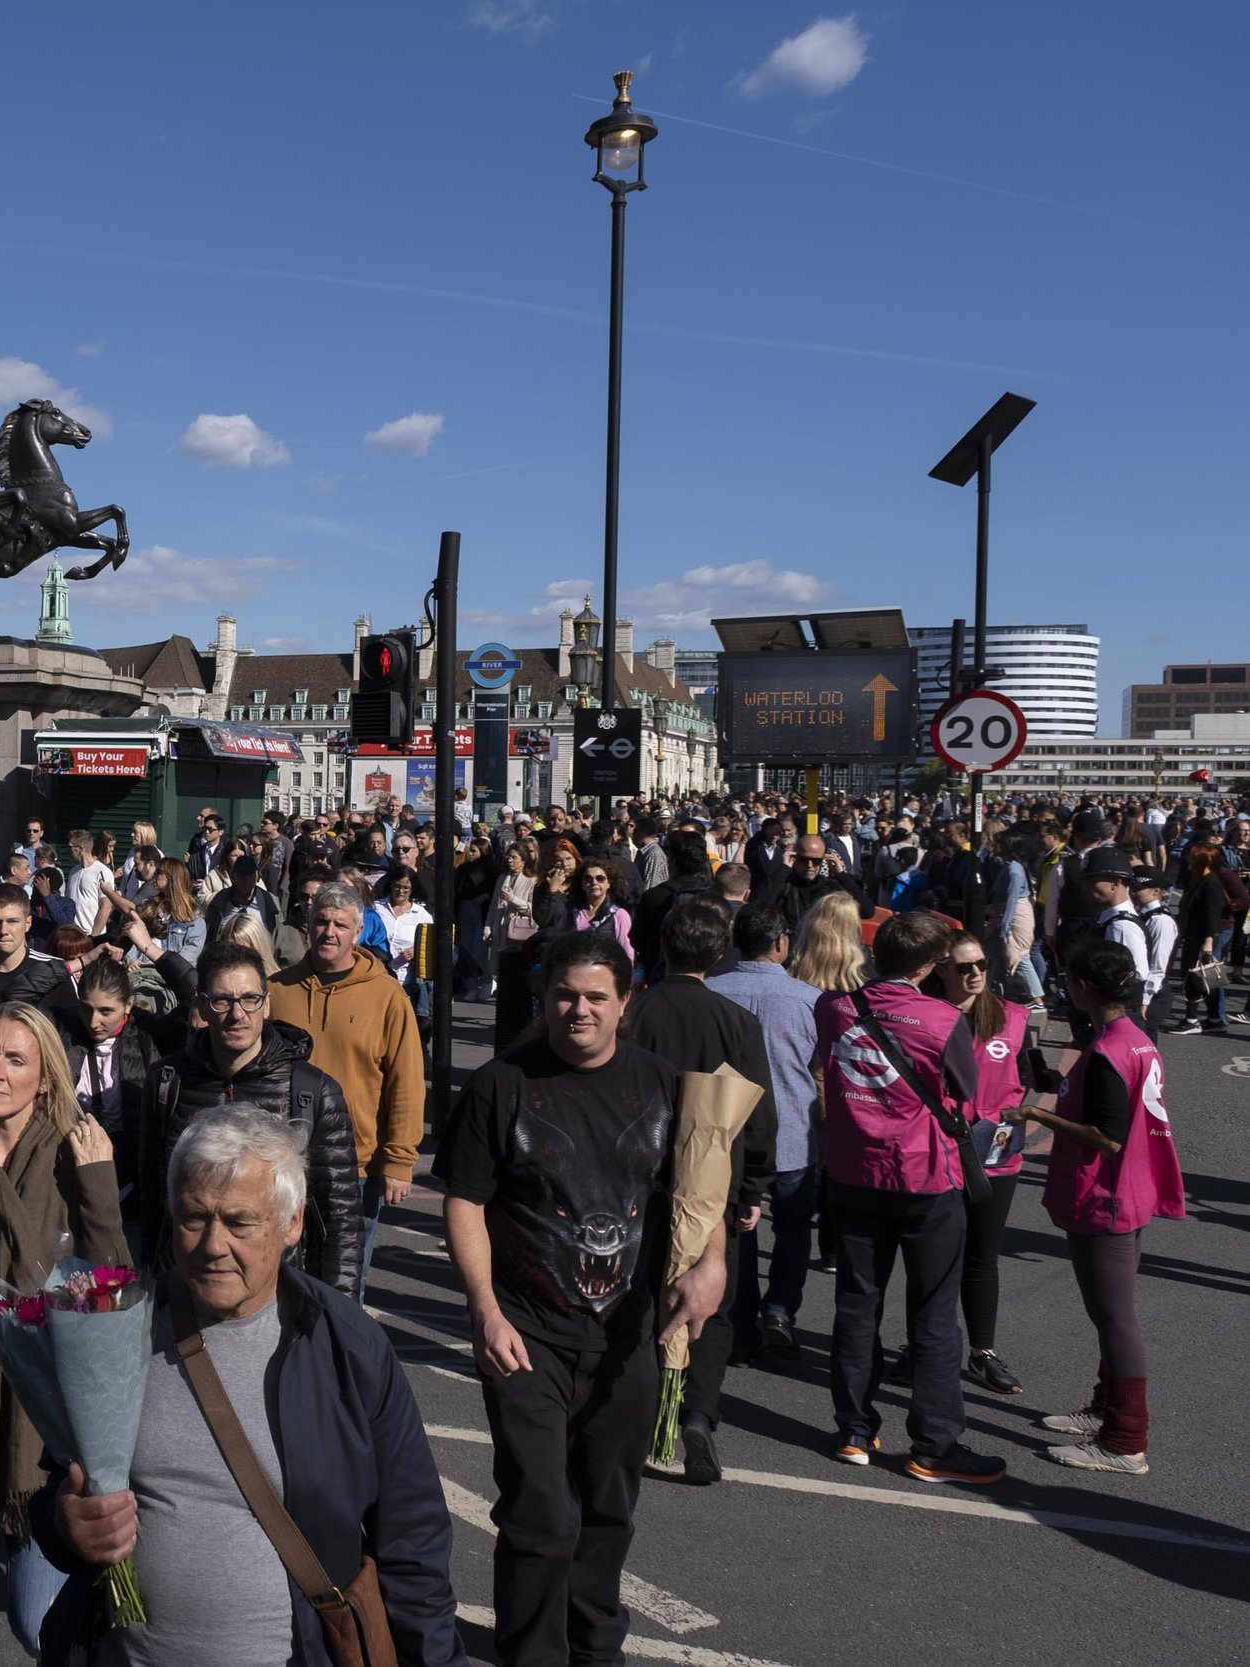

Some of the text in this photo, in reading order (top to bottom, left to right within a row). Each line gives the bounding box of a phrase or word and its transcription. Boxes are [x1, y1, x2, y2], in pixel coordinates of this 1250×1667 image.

[744, 691, 843, 706] WATERLOO
[757, 710, 843, 725] STATION
[946, 715, 1012, 749] 20
[77, 751, 124, 763] Buy Your
[77, 764, 145, 775] Tickets Here!
[888, 1012, 920, 1025] London
